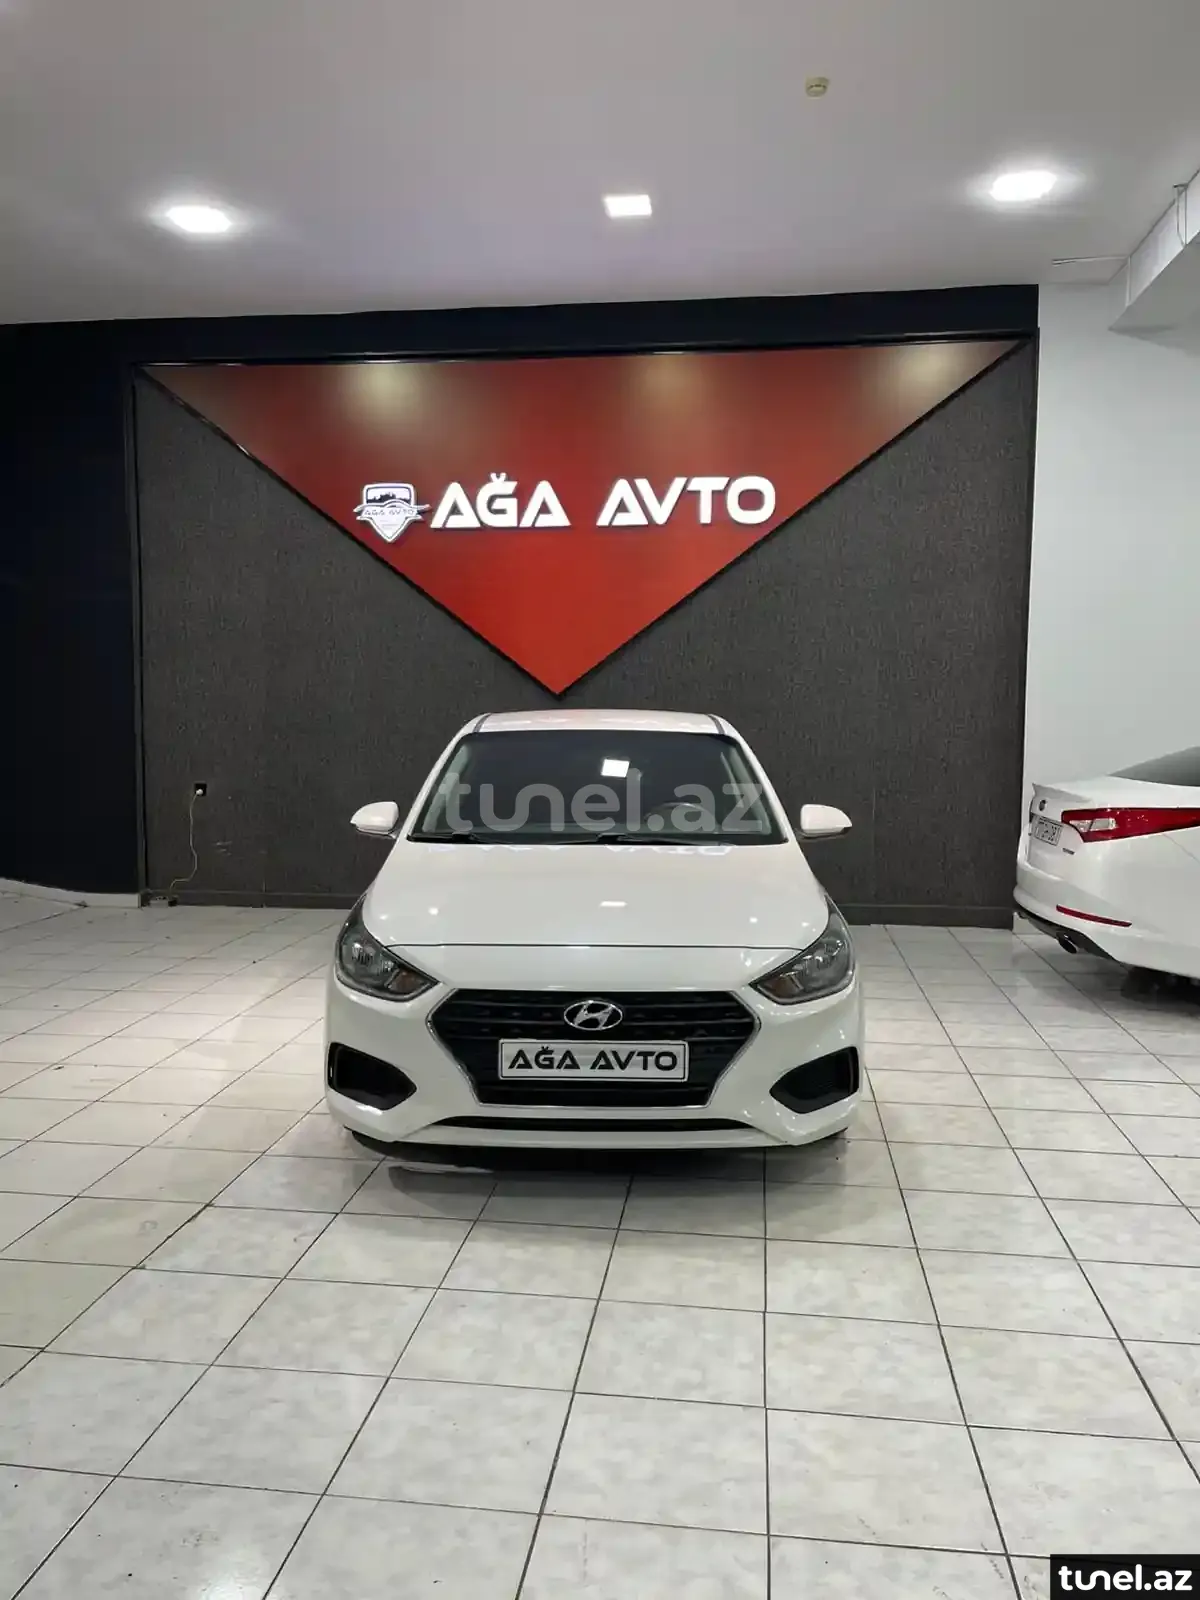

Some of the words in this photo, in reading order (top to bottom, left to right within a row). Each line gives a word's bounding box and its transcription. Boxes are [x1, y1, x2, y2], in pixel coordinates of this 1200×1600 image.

[430, 472, 571, 528] AĞA
[596, 475, 776, 526] AVTO
[508, 1046, 581, 1070] AĞA
[589, 1049, 678, 1071] AVTO
